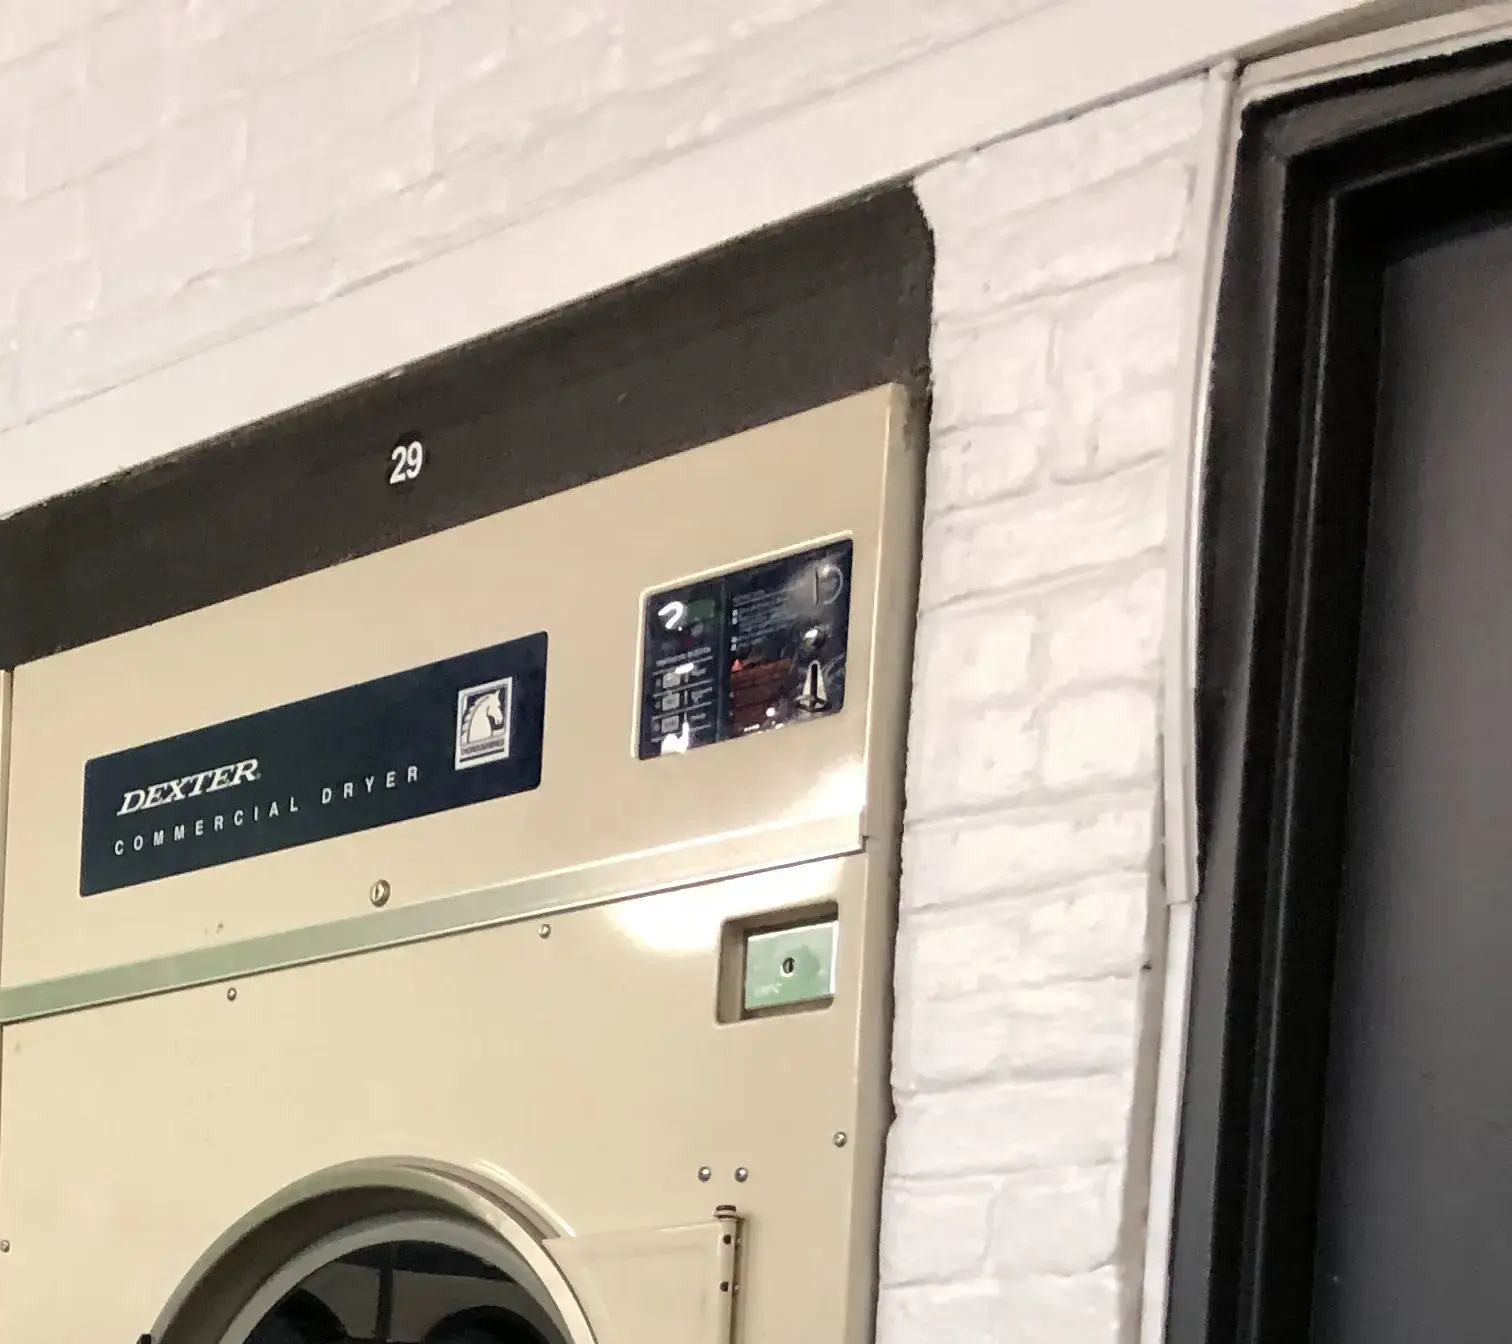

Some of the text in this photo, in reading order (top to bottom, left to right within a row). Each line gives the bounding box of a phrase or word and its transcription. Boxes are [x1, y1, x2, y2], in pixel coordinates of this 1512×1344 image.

[389, 440, 424, 485] 29
[114, 765, 418, 856] COMMERCIAL DRYER
[116, 758, 259, 817] DEXTER
